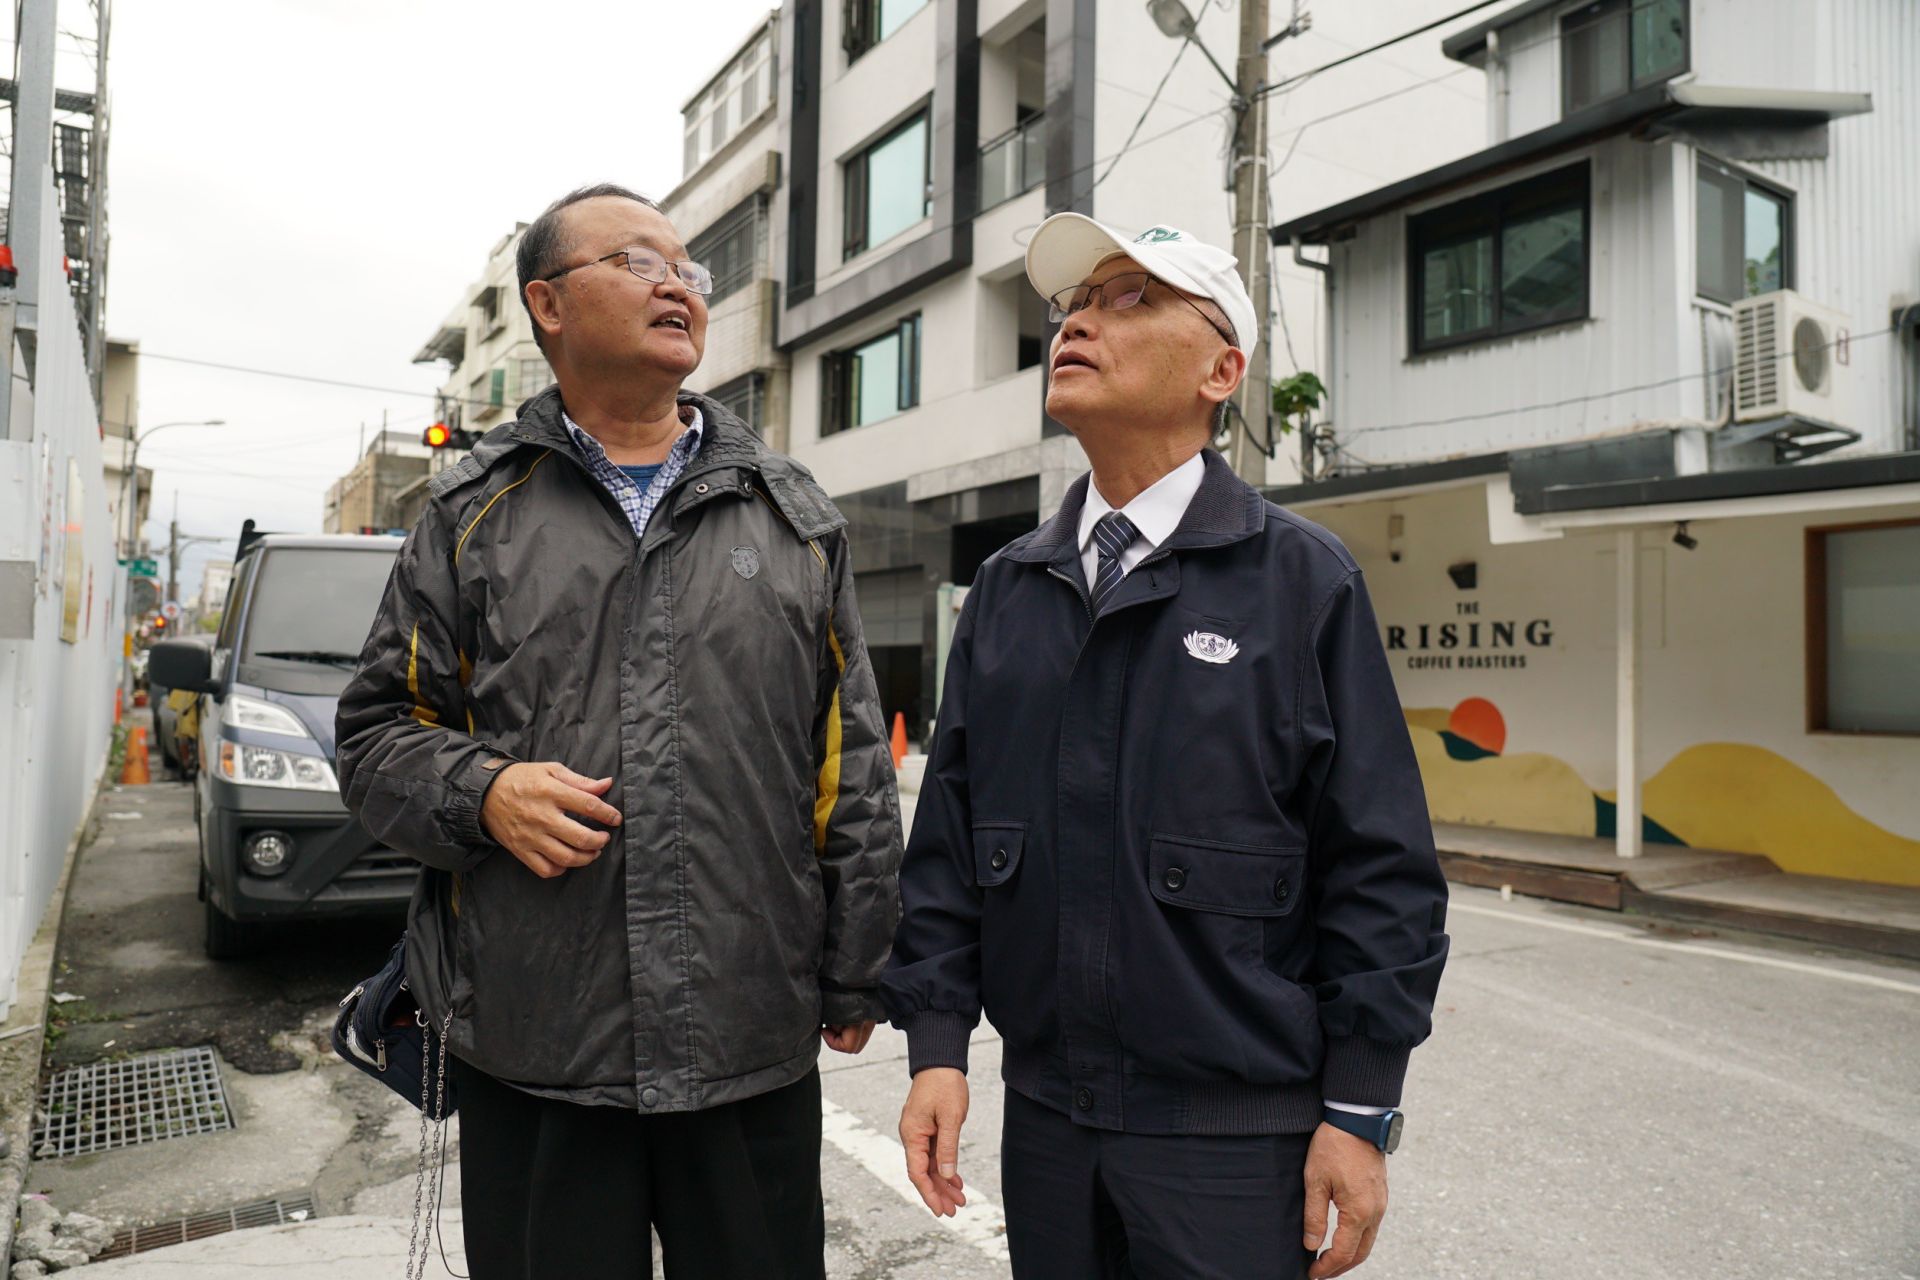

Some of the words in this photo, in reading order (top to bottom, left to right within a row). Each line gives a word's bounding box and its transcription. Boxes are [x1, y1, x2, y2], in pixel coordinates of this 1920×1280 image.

[1456, 602, 1479, 615] THE
[1386, 619, 1554, 650] RISING
[1407, 656, 1452, 669] COFFEE
[1457, 655, 1527, 669] ROASTERS
